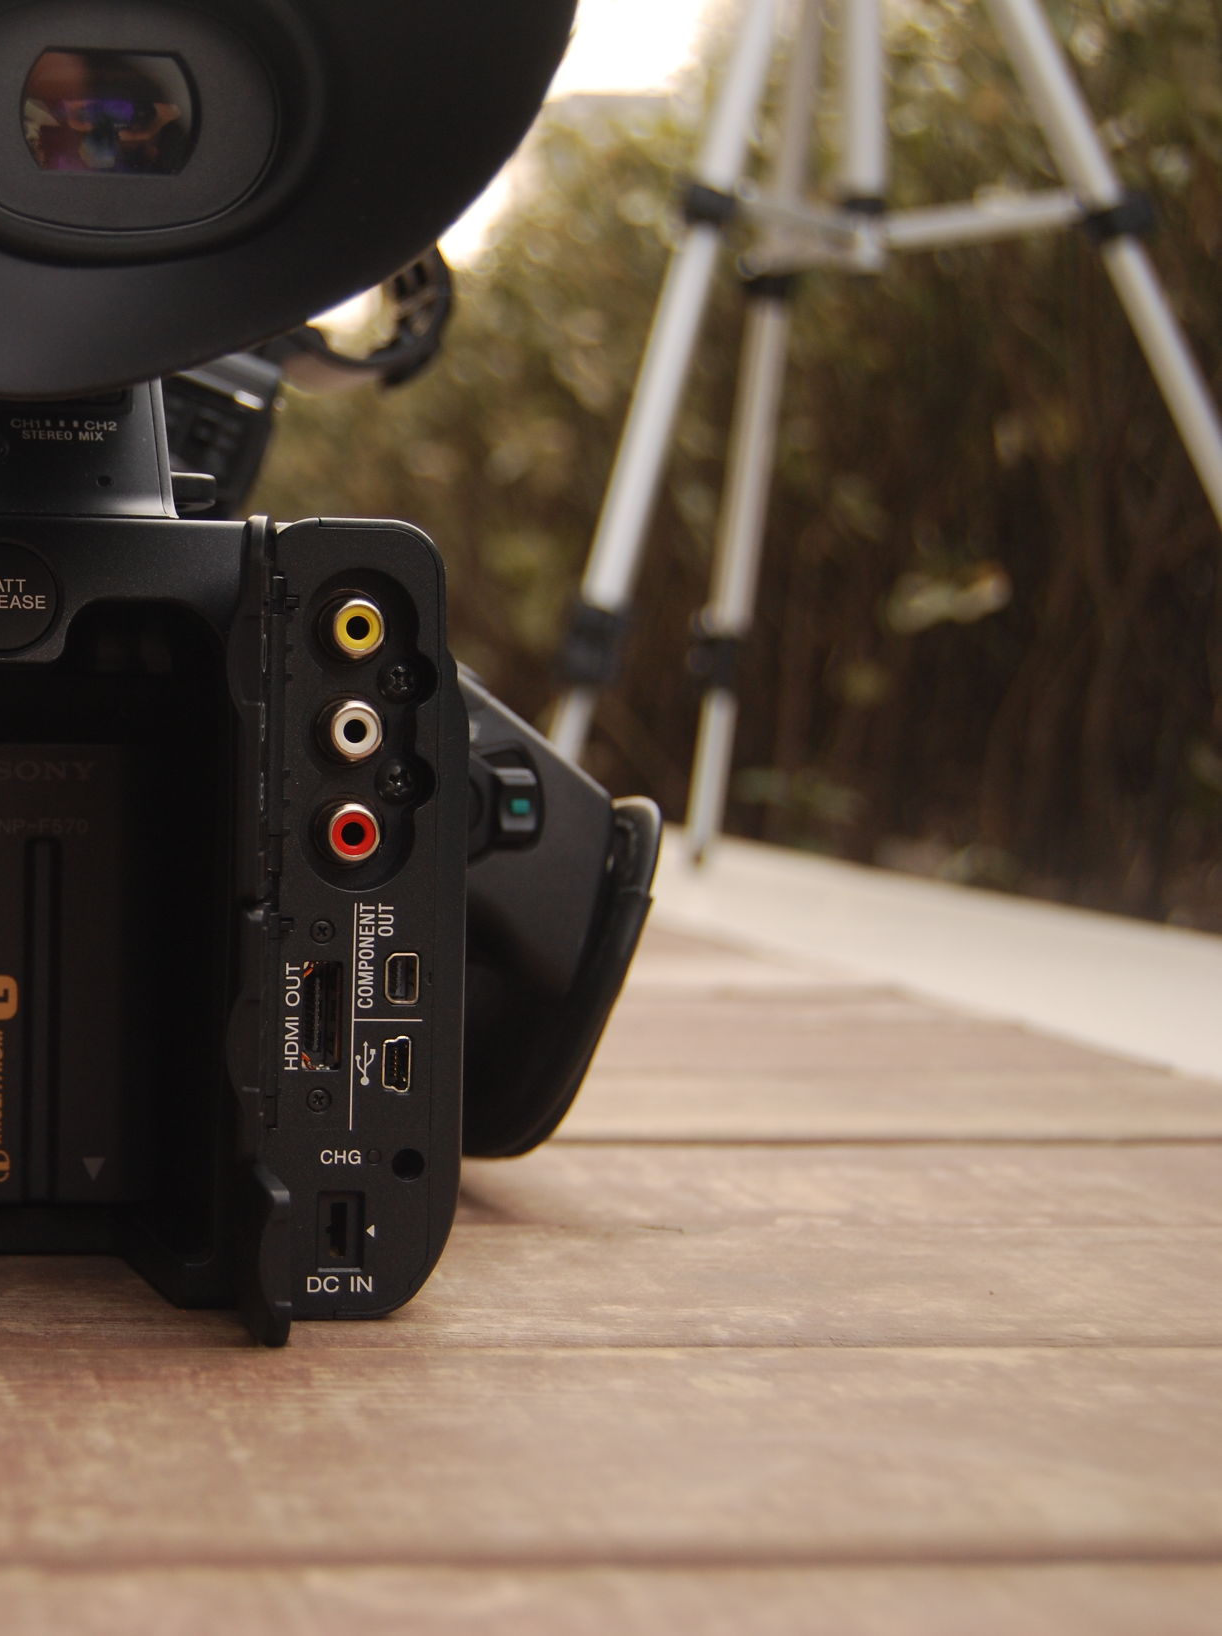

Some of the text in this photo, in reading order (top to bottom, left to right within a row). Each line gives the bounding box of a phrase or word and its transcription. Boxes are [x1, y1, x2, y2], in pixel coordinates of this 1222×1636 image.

[10, 418, 118, 432] CH1 CH2
[21, 429, 105, 442] STEREO MIX
[378, 902, 395, 937] OUT
[357, 902, 376, 1009] COMPONENT
[284, 962, 301, 1071] HDMI OUT
[320, 1150, 362, 1165] CHG
[306, 1276, 373, 1293] DC IN
